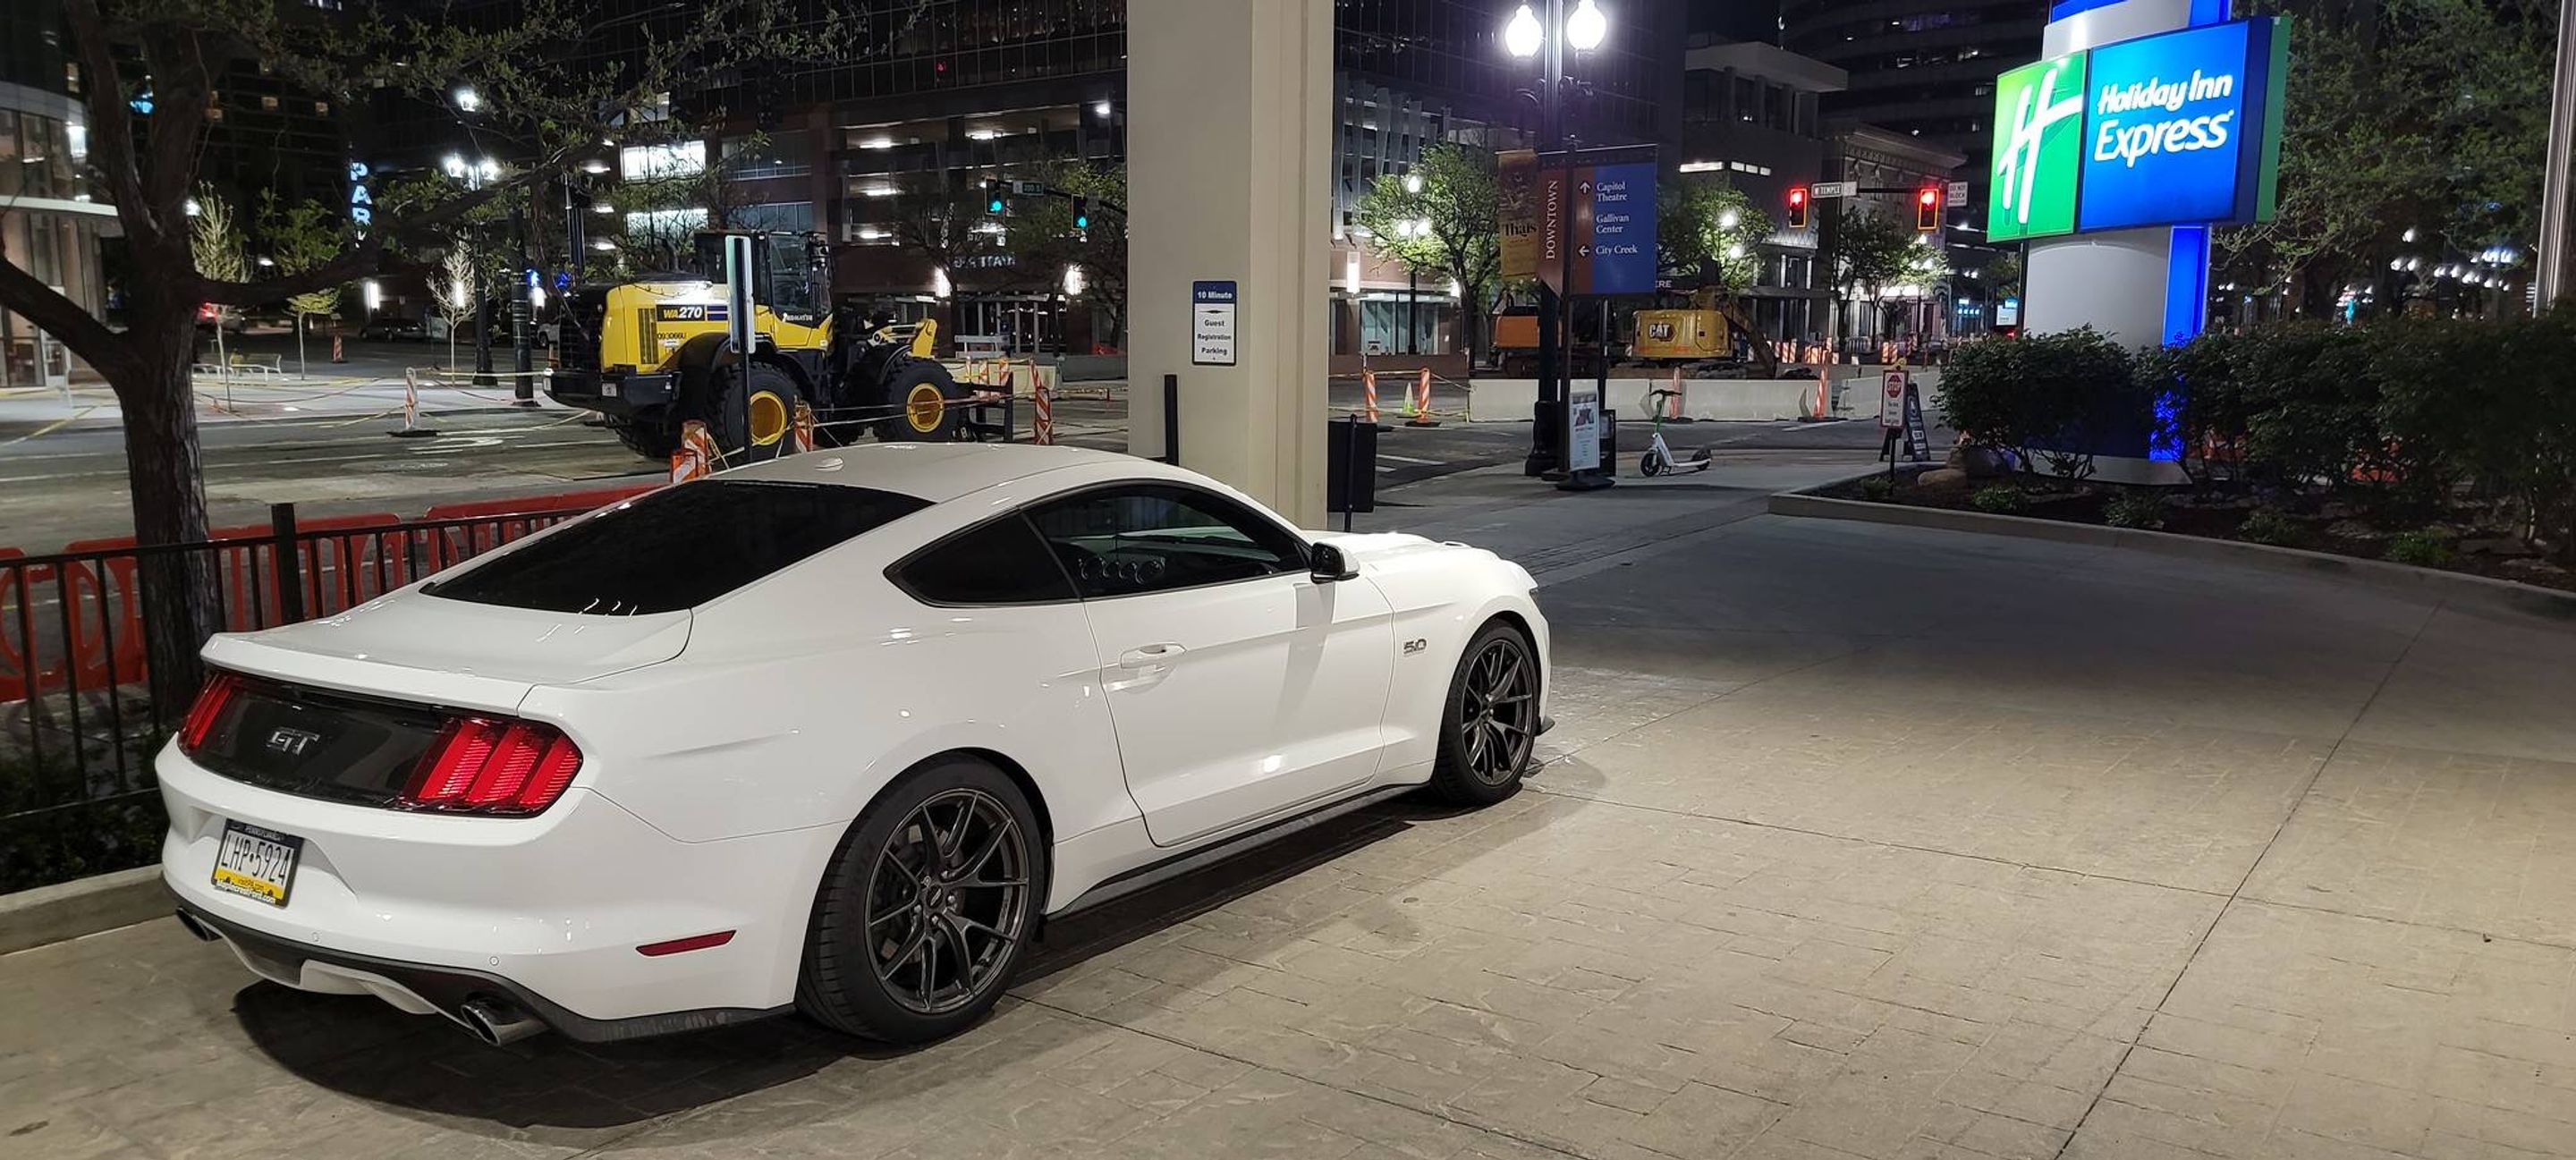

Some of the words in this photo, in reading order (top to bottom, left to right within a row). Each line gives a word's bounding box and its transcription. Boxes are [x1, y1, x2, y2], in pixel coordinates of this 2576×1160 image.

[2097, 76, 2188, 113] Holiday
[2188, 69, 2233, 102] Inn
[2094, 114, 2230, 168] Express
[1597, 182, 1625, 193] Capitol
[1597, 192, 1628, 202] Theatre
[1546, 180, 1559, 259] DOWNTOWN
[1596, 213, 1630, 224] Gallivan
[1596, 224, 1623, 233] Center
[1596, 246, 1612, 256] City
[1614, 244, 1638, 254] Creek
[1198, 291, 1207, 299] 10
[1208, 291, 1233, 299] Minute
[663, 306, 703, 318] WA270
[1648, 324, 1670, 337] CAT
[1197, 333, 1232, 342] Registration
[1201, 347, 1228, 356] Parking
[1403, 638, 1427, 654] 5.0
[267, 726, 321, 756] GT
